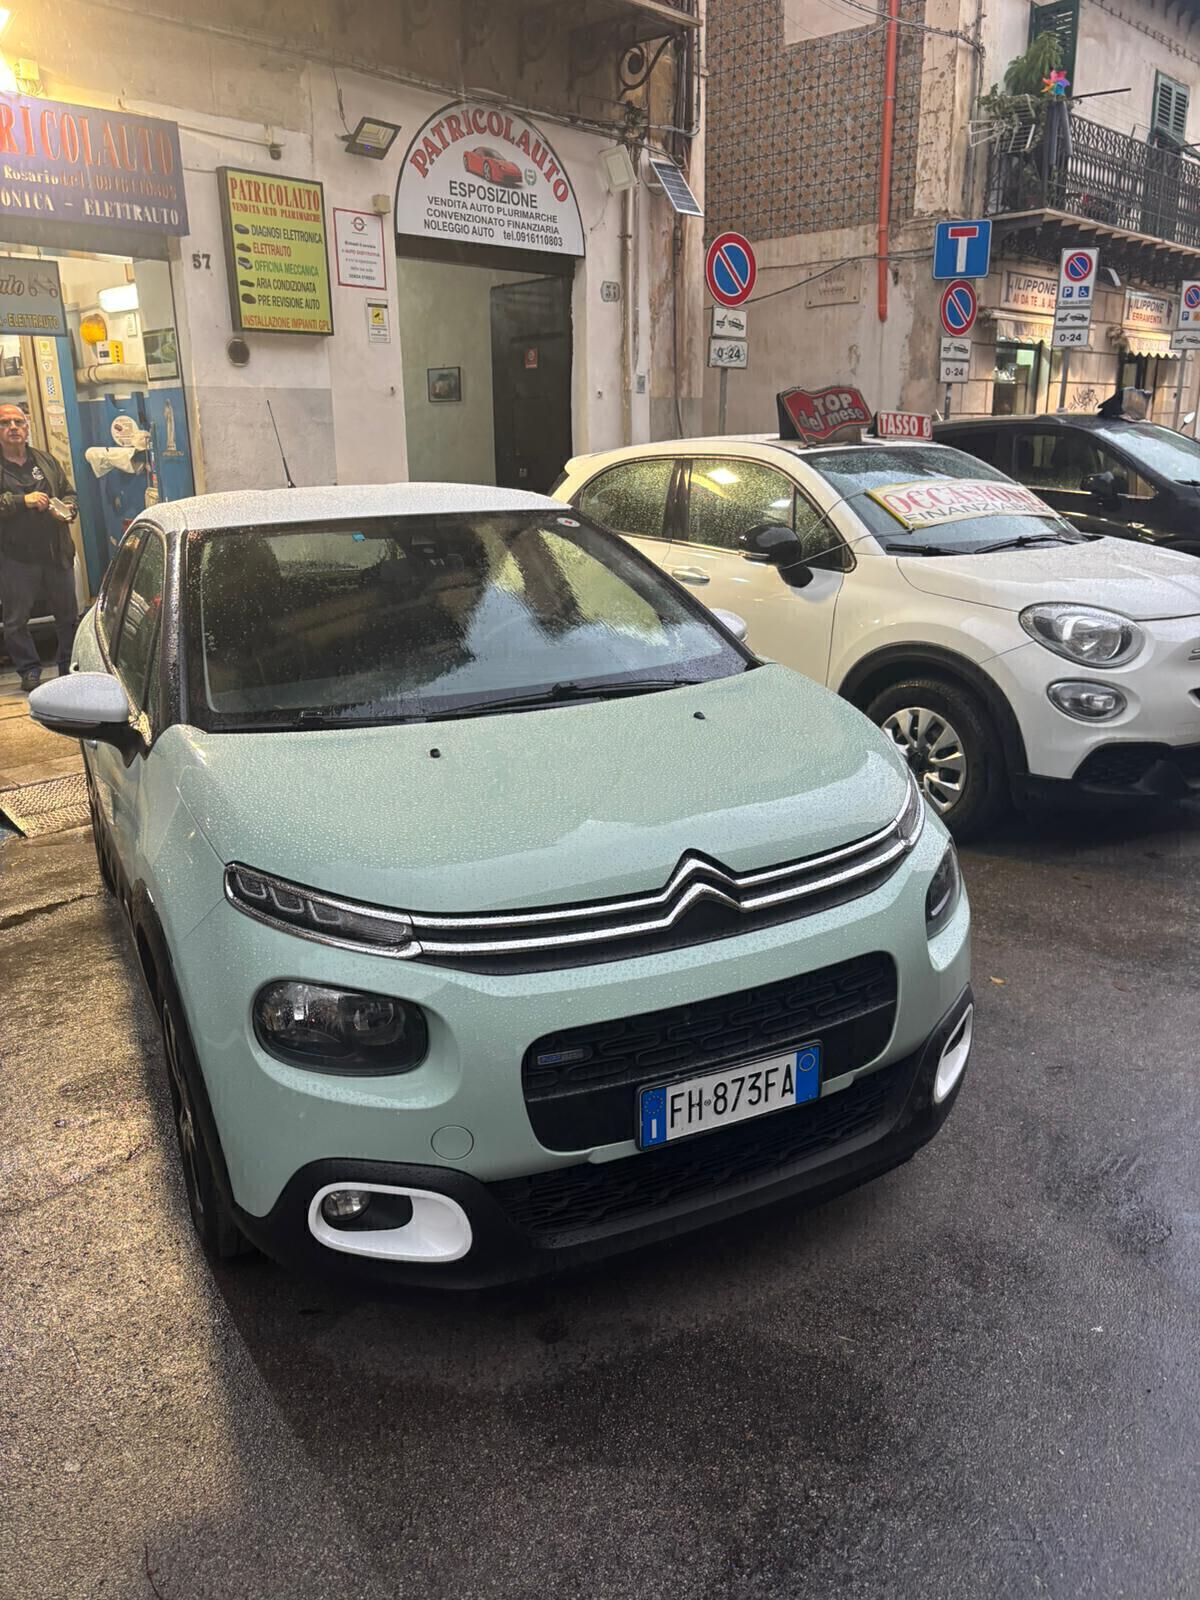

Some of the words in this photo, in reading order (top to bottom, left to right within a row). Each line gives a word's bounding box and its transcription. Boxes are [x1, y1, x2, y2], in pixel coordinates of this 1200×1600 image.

[410, 107, 569, 203] PATRICOLAUTO
[4, 164, 59, 185] Rosario
[230, 177, 320, 212] PATRICOLAUTO
[449, 180, 538, 209] ESPOSIZIONE
[84, 197, 179, 225] ELETTRAUTO
[427, 195, 468, 211] VENDITA
[469, 203, 495, 215] AUTO
[497, 206, 558, 224] PLURIMARCHE
[423, 218, 470, 235] NOLEGGIO
[471, 225, 495, 239] AUTO
[426, 208, 505, 227] CONVENZIONATO
[507, 220, 560, 235] FINANZIARIA
[251, 224, 281, 240] DIAGNOSI
[283, 228, 323, 244] ELETTRONICA
[252, 241, 292, 257] ELETTRAUTO
[192, 253, 211, 270] 57
[254, 259, 282, 274] OFFICINA
[284, 262, 319, 277] MECCANICA
[257, 277, 272, 289] ARIA
[273, 279, 317, 294] CONDIZIONATA
[258, 295, 271, 306] PRE
[272, 295, 304, 309] REVISIONE
[305, 298, 320, 310] AUTO
[7, 313, 61, 330] ELETTRAUTO
[243, 315, 290, 329] INSTALLAZIONE
[291, 318, 318, 330] IMPIANTI
[319, 319, 330, 331] GPL
[1059, 333, 1082, 343] 0-24
[716, 348, 741, 360] 0-24
[945, 367, 964, 377] 0-24
[813, 393, 853, 416] TOP
[799, 410, 826, 431] del
[827, 407, 865, 426] mese
[881, 413, 918, 436] TASSO
